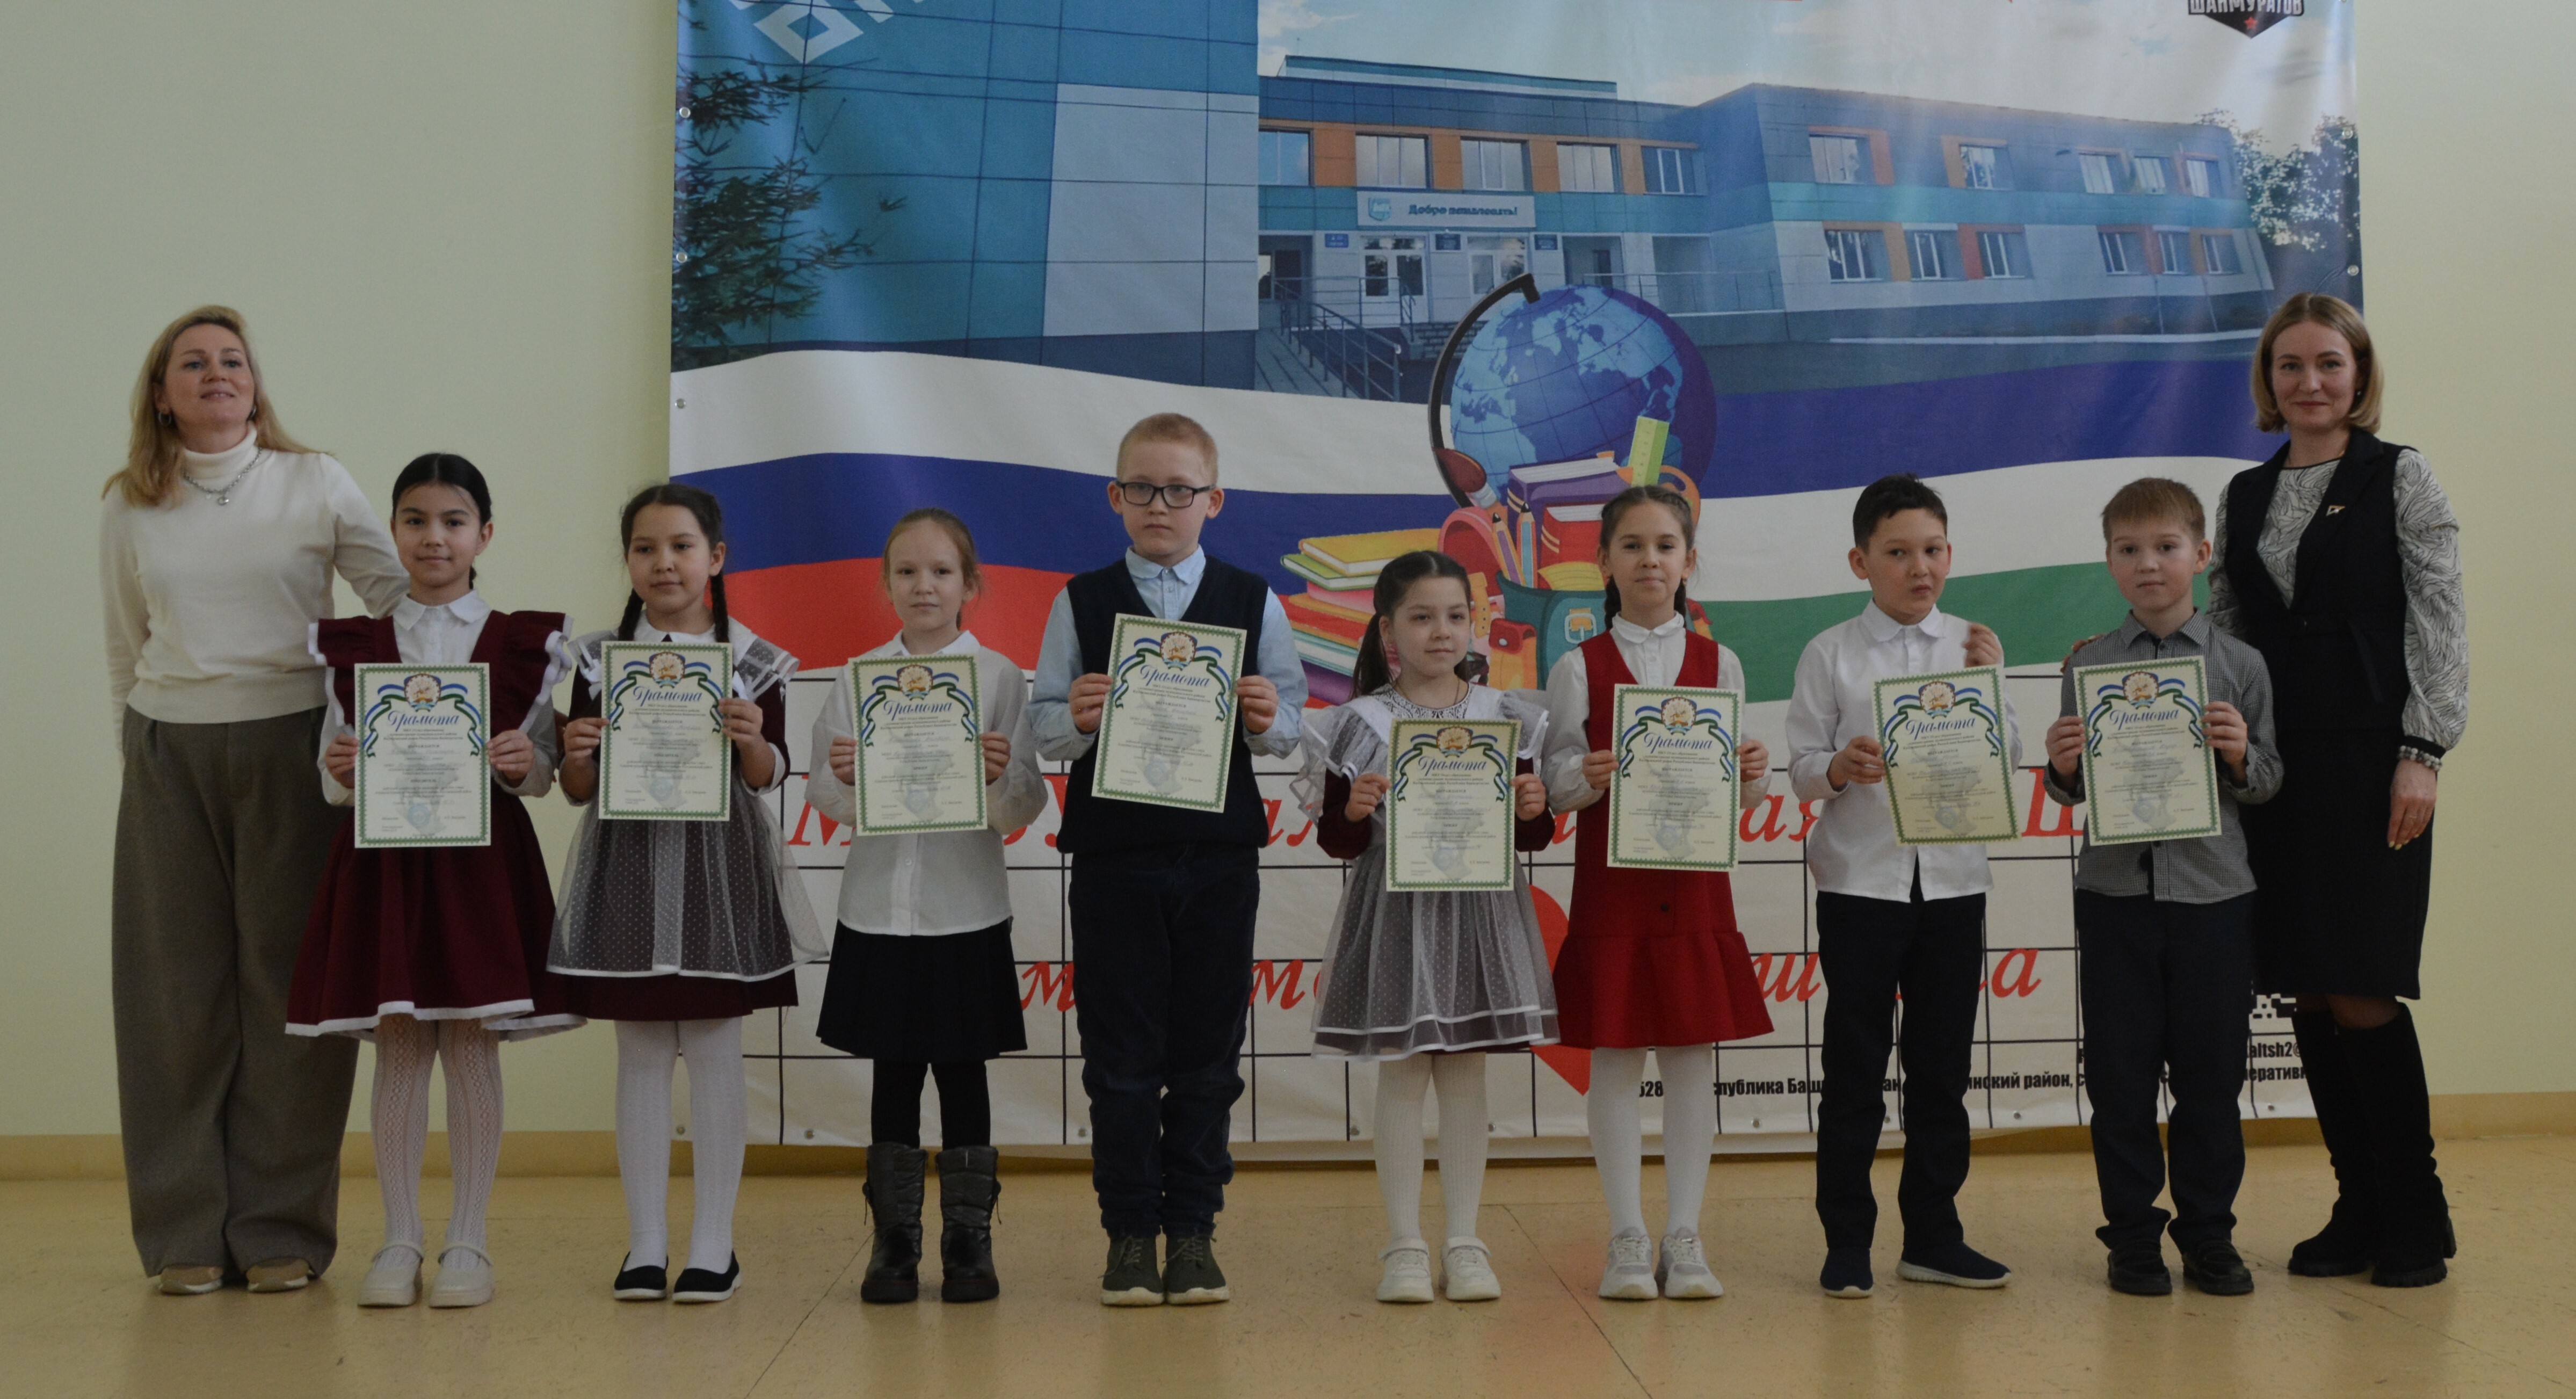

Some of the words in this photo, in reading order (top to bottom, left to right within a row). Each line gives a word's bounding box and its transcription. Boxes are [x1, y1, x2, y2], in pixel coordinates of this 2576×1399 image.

[1409, 204, 1447, 216] Добро
[1140, 664, 1210, 687] Грамота
[633, 685, 703, 707] Грамота
[387, 710, 460, 731] Грамота
[883, 700, 952, 721] Грамота
[2109, 708, 2180, 731] Грамота
[1905, 717, 1976, 741] Грамота
[1643, 732, 1713, 754] Грамота
[1418, 755, 1487, 777] Грамота
[2023, 1071, 2073, 1090] район,
